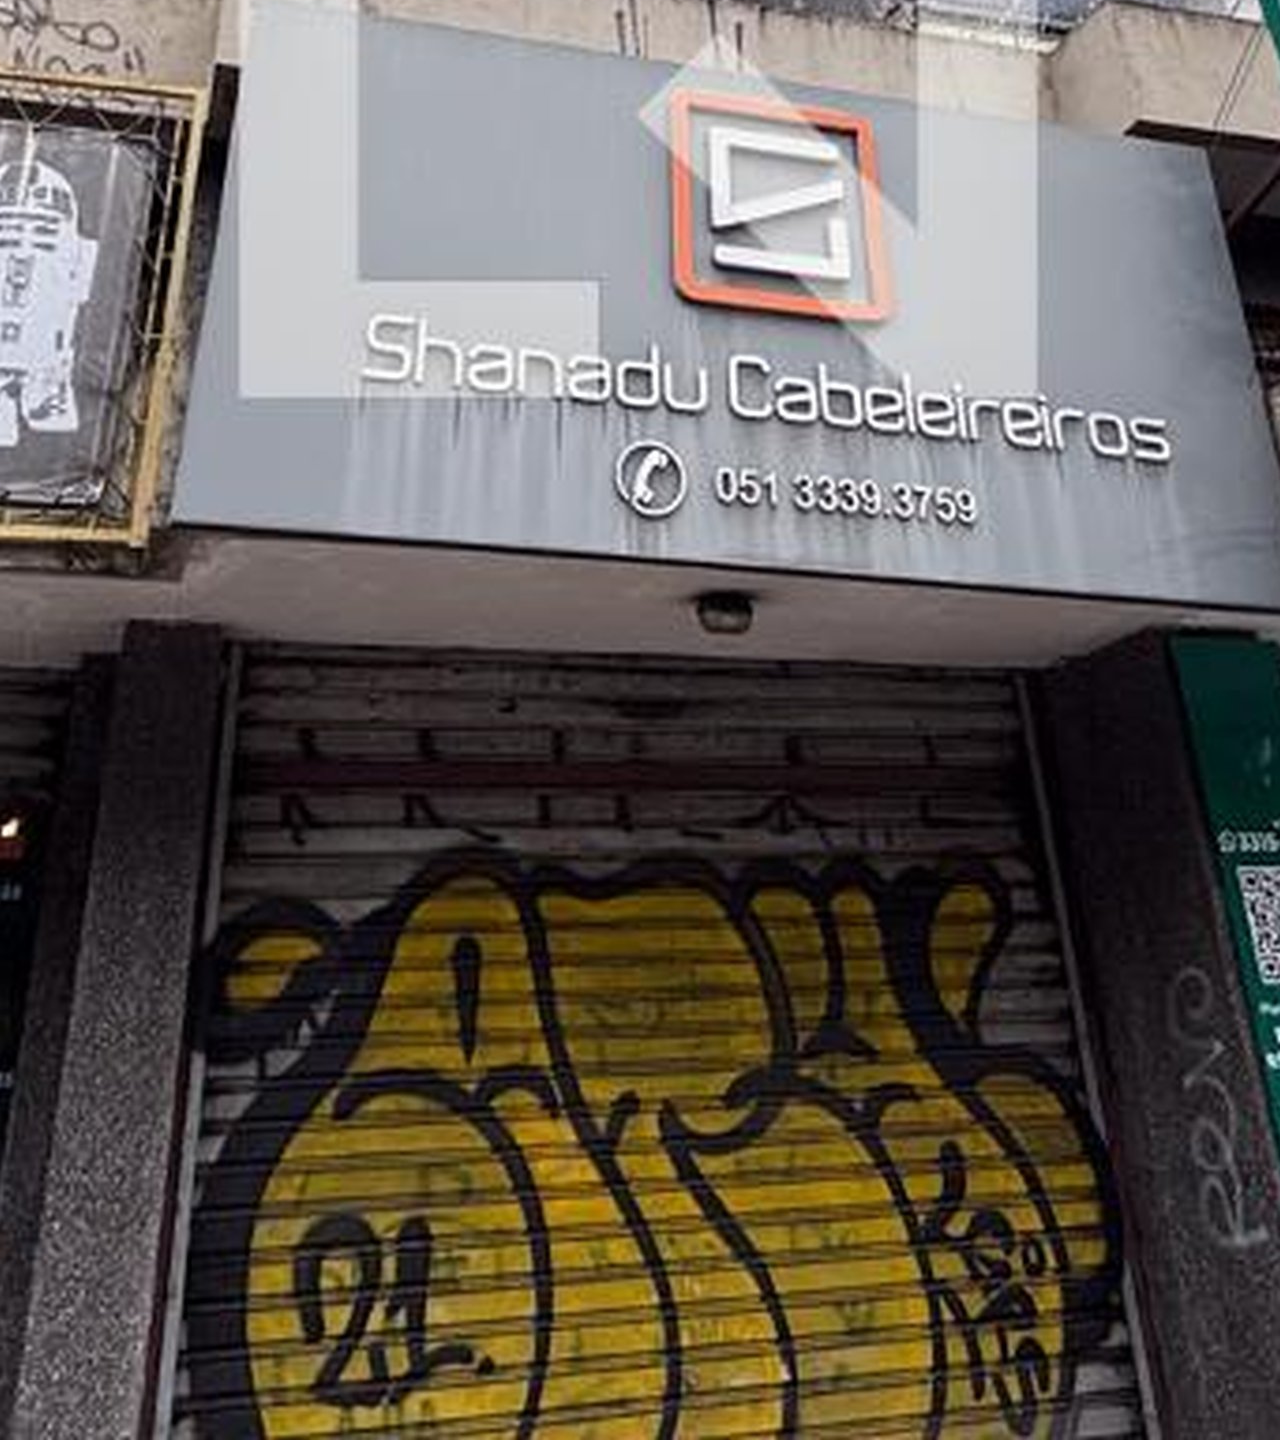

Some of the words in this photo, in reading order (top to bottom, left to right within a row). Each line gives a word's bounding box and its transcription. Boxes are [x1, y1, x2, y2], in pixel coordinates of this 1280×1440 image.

[360, 313, 710, 415] Shanadu
[728, 353, 1174, 464] Cabeleireiros
[716, 466, 781, 507] 051
[793, 471, 978, 525] 3339.3759
